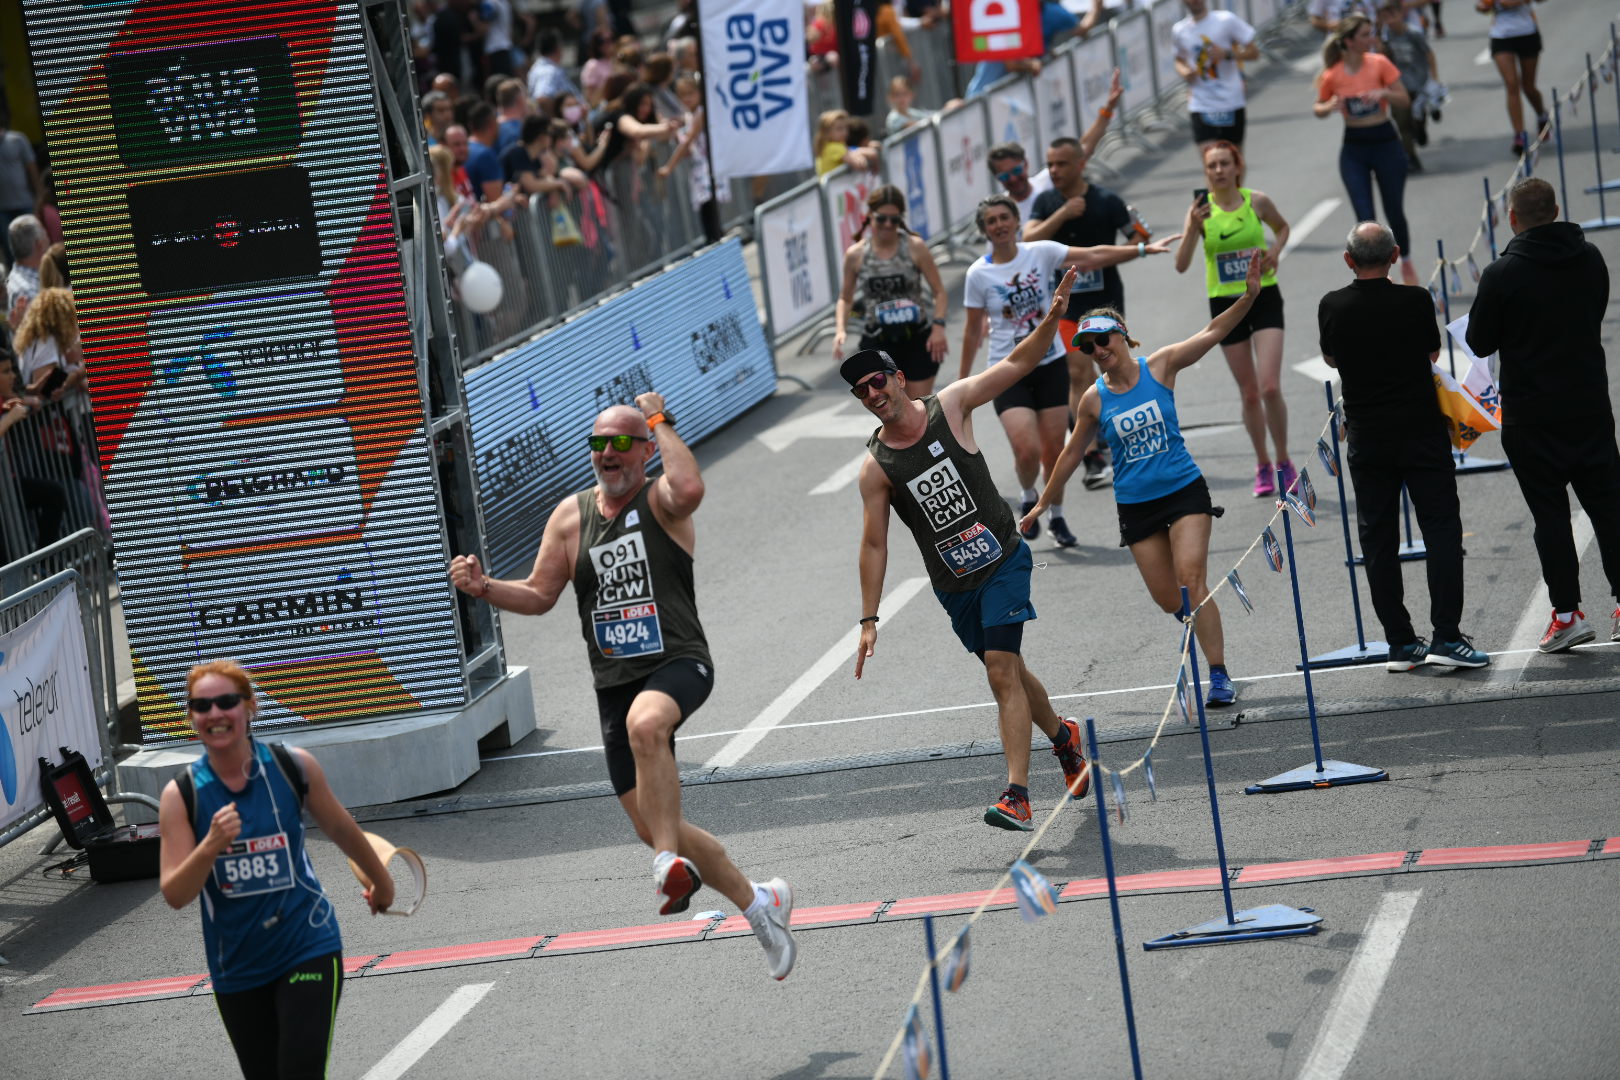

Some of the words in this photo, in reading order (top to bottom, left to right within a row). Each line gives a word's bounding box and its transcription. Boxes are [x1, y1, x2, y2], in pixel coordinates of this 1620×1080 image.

[1119, 406, 1159, 432] 091
[1126, 424, 1161, 444] RUN
[916, 465, 956, 497] 091
[924, 482, 963, 513] RUN
[933, 498, 968, 526] CrW
[600, 539, 640, 569] 091
[950, 537, 990, 565] 5436
[602, 562, 643, 587] RUN
[604, 621, 650, 645] 4924
[224, 853, 280, 882] 5883
